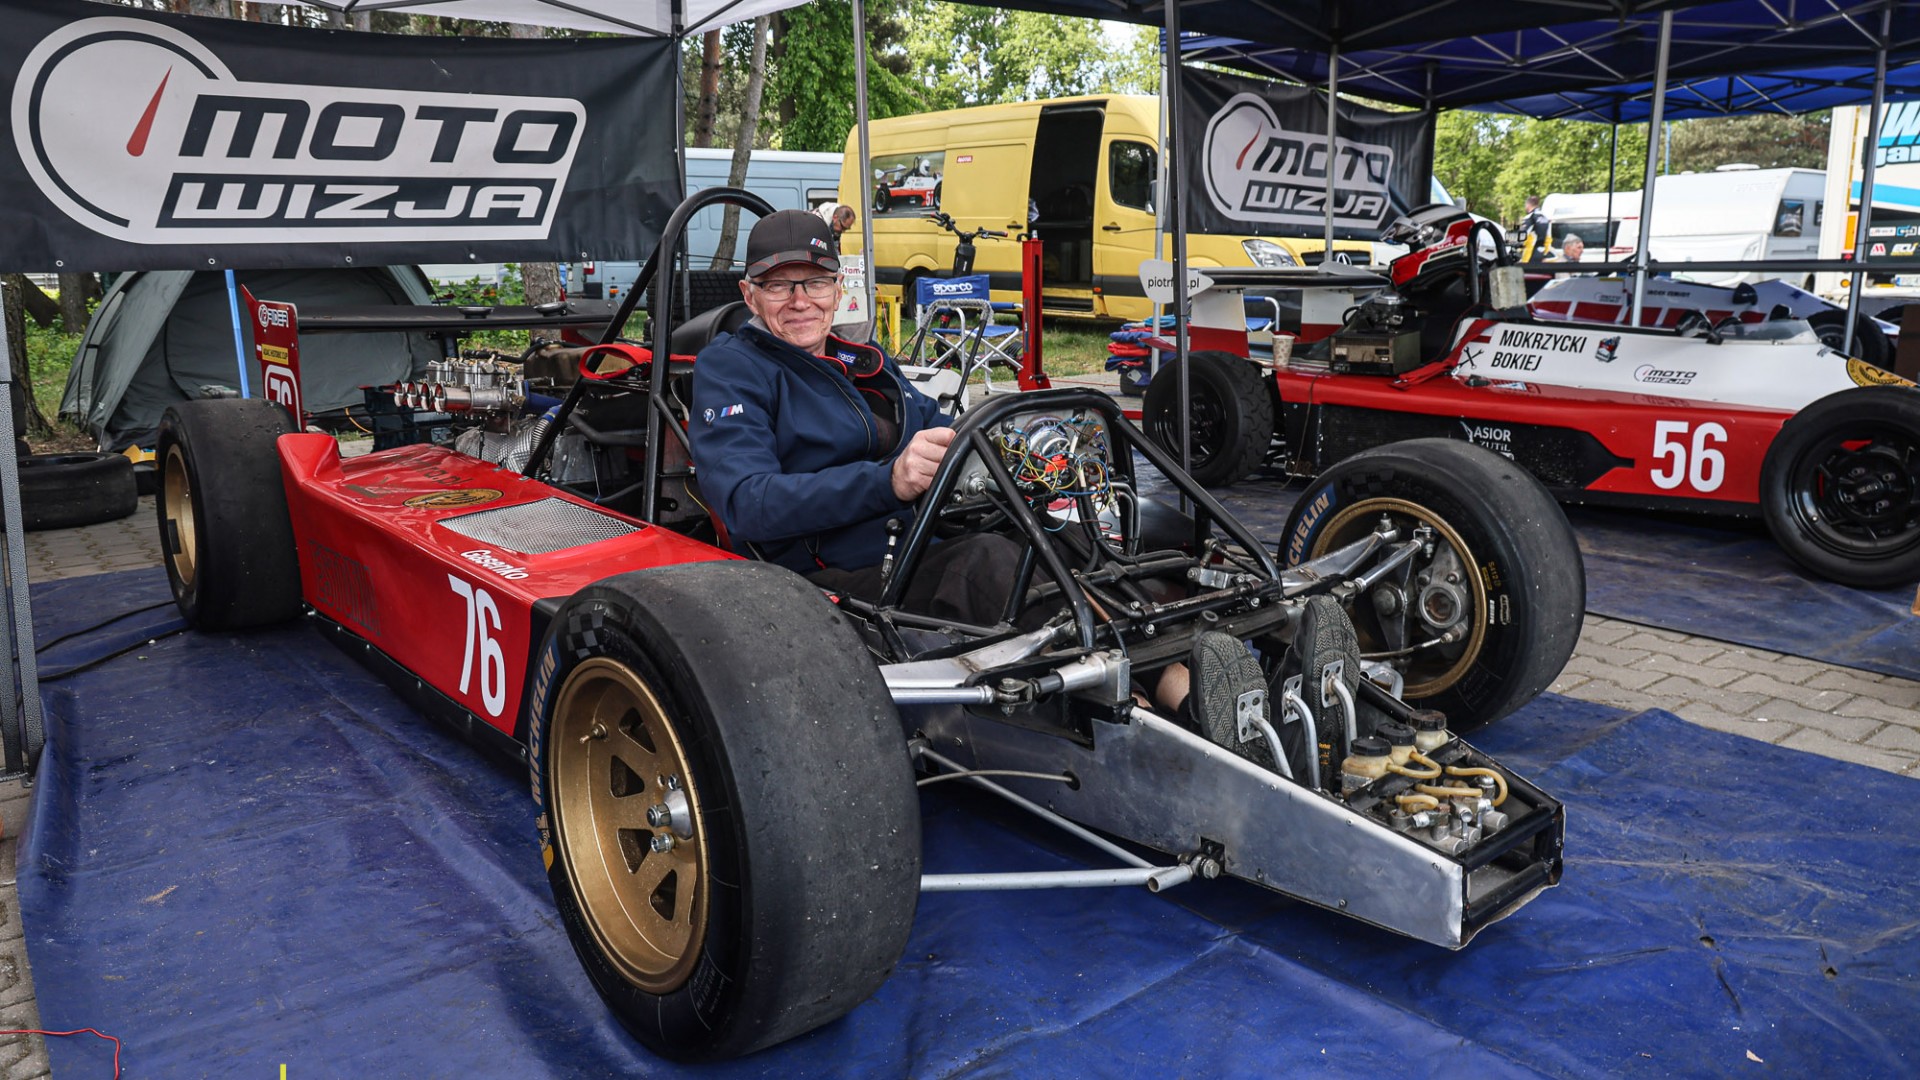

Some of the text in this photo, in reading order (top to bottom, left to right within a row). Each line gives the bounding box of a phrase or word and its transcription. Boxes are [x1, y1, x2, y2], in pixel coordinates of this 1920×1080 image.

[178, 93, 578, 164] MOTO
[1252, 136, 1390, 185] MOTO
[171, 181, 543, 219] WIZJA
[1245, 185, 1384, 217] WIZJA
[933, 282, 973, 294] sparco
[1490, 351, 1542, 372] BOKIEJ
[1499, 329, 1587, 354] MOKRZYCKI
[1648, 369, 1698, 378] MOTO
[1650, 419, 1728, 493] 56
[1287, 492, 1330, 567] CHELIN
[447, 573, 506, 717] 76
[529, 645, 557, 806] MICHELIN
